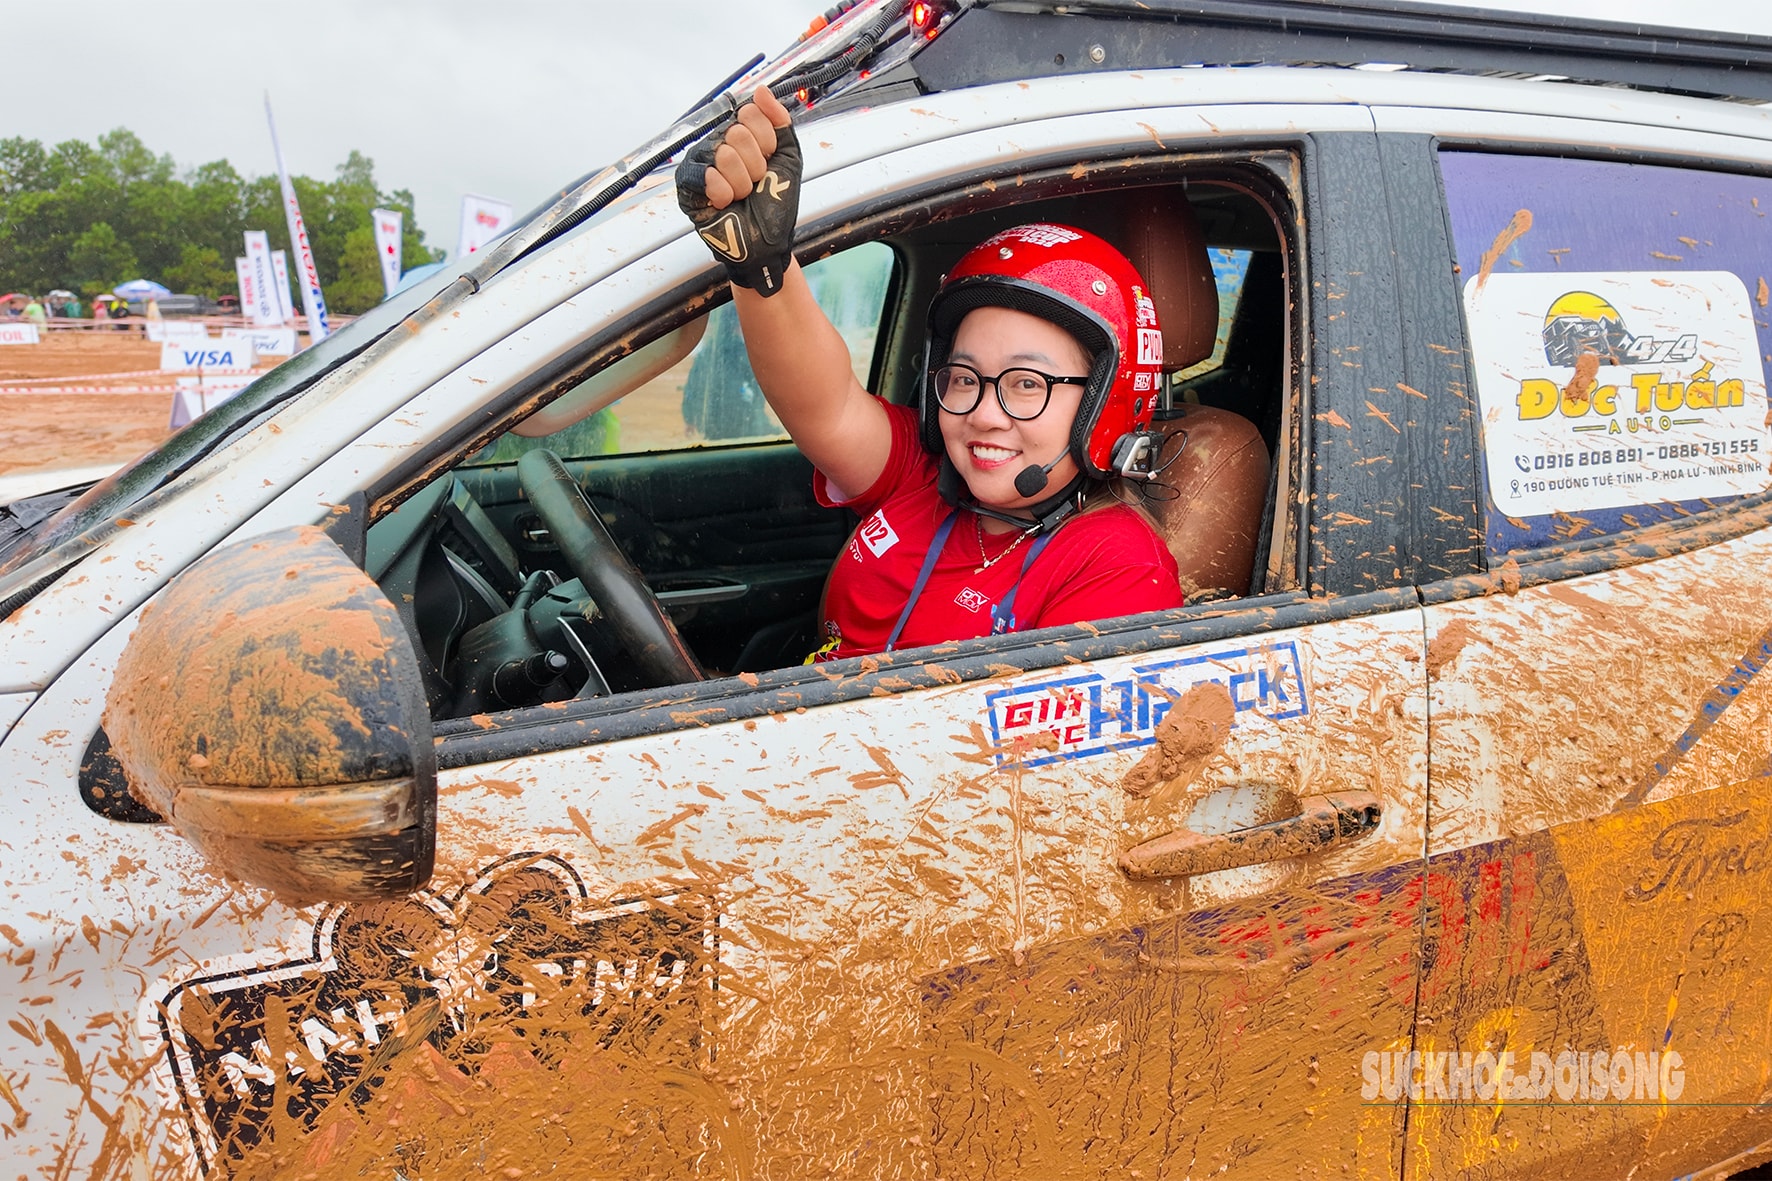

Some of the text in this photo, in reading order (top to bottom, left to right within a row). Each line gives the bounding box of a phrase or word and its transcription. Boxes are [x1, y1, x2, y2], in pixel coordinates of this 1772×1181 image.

[183, 350, 233, 367] VISA
[1631, 360, 1745, 415] Tuấn
[1608, 416, 1672, 434] AUTO
[1534, 453, 1574, 470] 0916
[1578, 450, 1612, 467] 808
[1616, 447, 1642, 464] 891
[1702, 441, 1727, 456] 751
[1730, 439, 1759, 454] 555
[1523, 481, 1546, 493] 190
[1709, 464, 1735, 477] NINH
